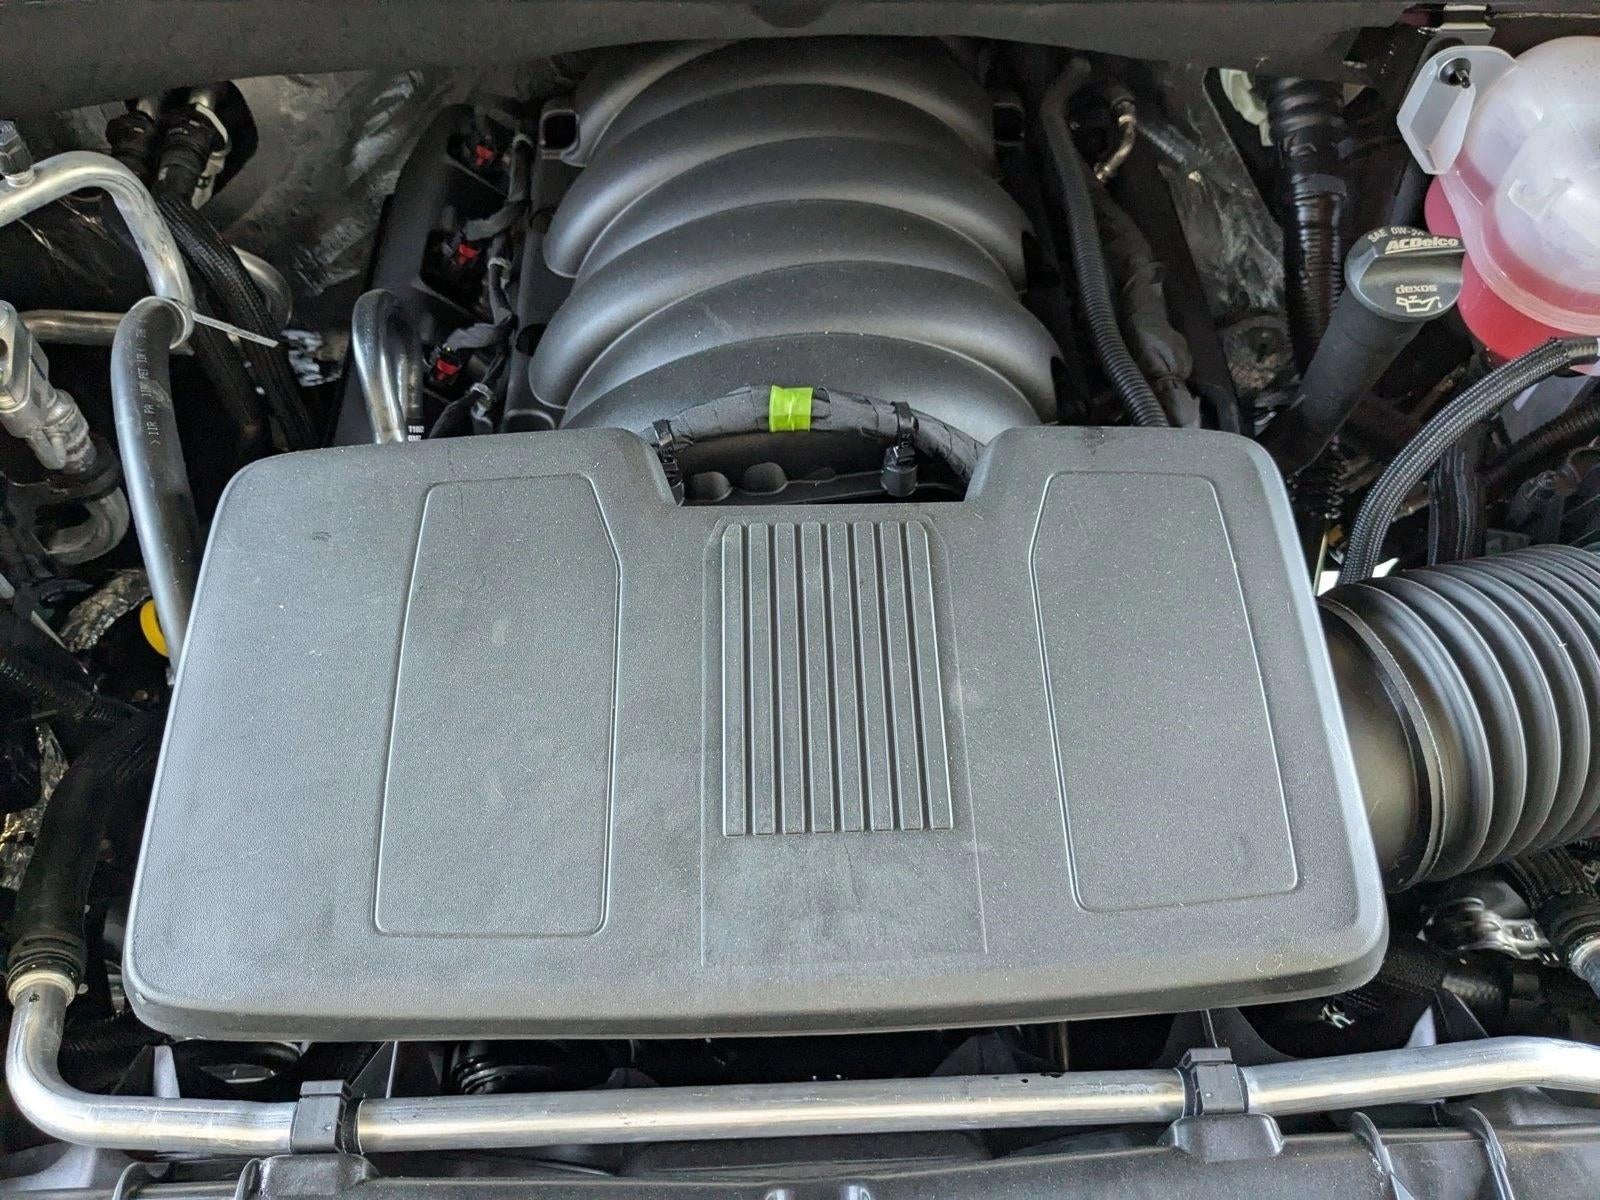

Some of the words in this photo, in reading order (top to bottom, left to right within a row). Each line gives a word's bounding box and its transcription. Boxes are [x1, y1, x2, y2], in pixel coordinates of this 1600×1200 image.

[1367, 229, 1388, 243] SAE
[1386, 236, 1460, 252] ACDelco
[1395, 285, 1438, 295] dexos
